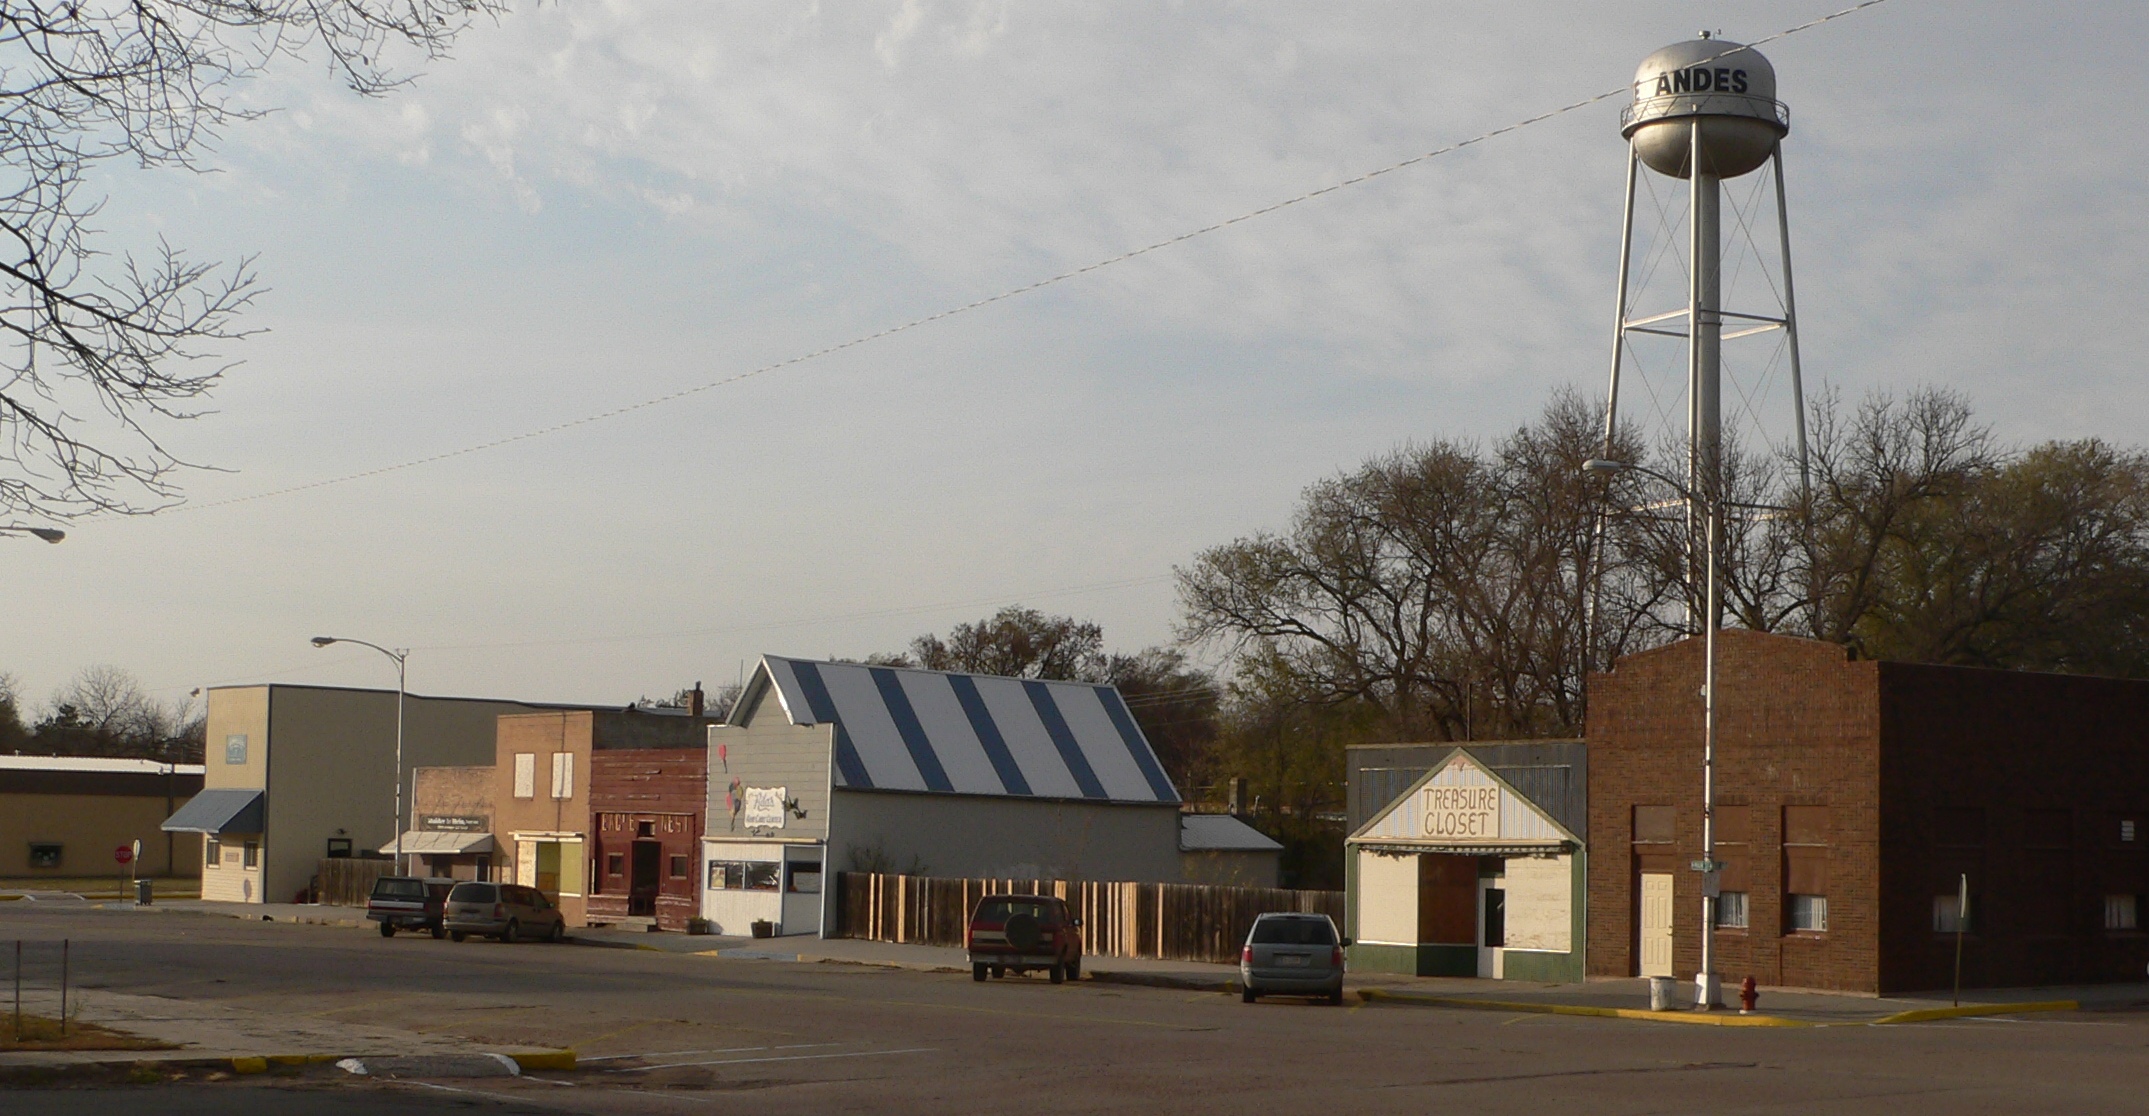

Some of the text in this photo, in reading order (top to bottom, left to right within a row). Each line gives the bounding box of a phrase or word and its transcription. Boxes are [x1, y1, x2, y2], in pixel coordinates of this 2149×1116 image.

[1655, 69, 1748, 96] ANDES
[1423, 788, 1497, 810] TREASURE
[1424, 812, 1489, 835] CLOSET
[115, 850, 132, 859] STOP
